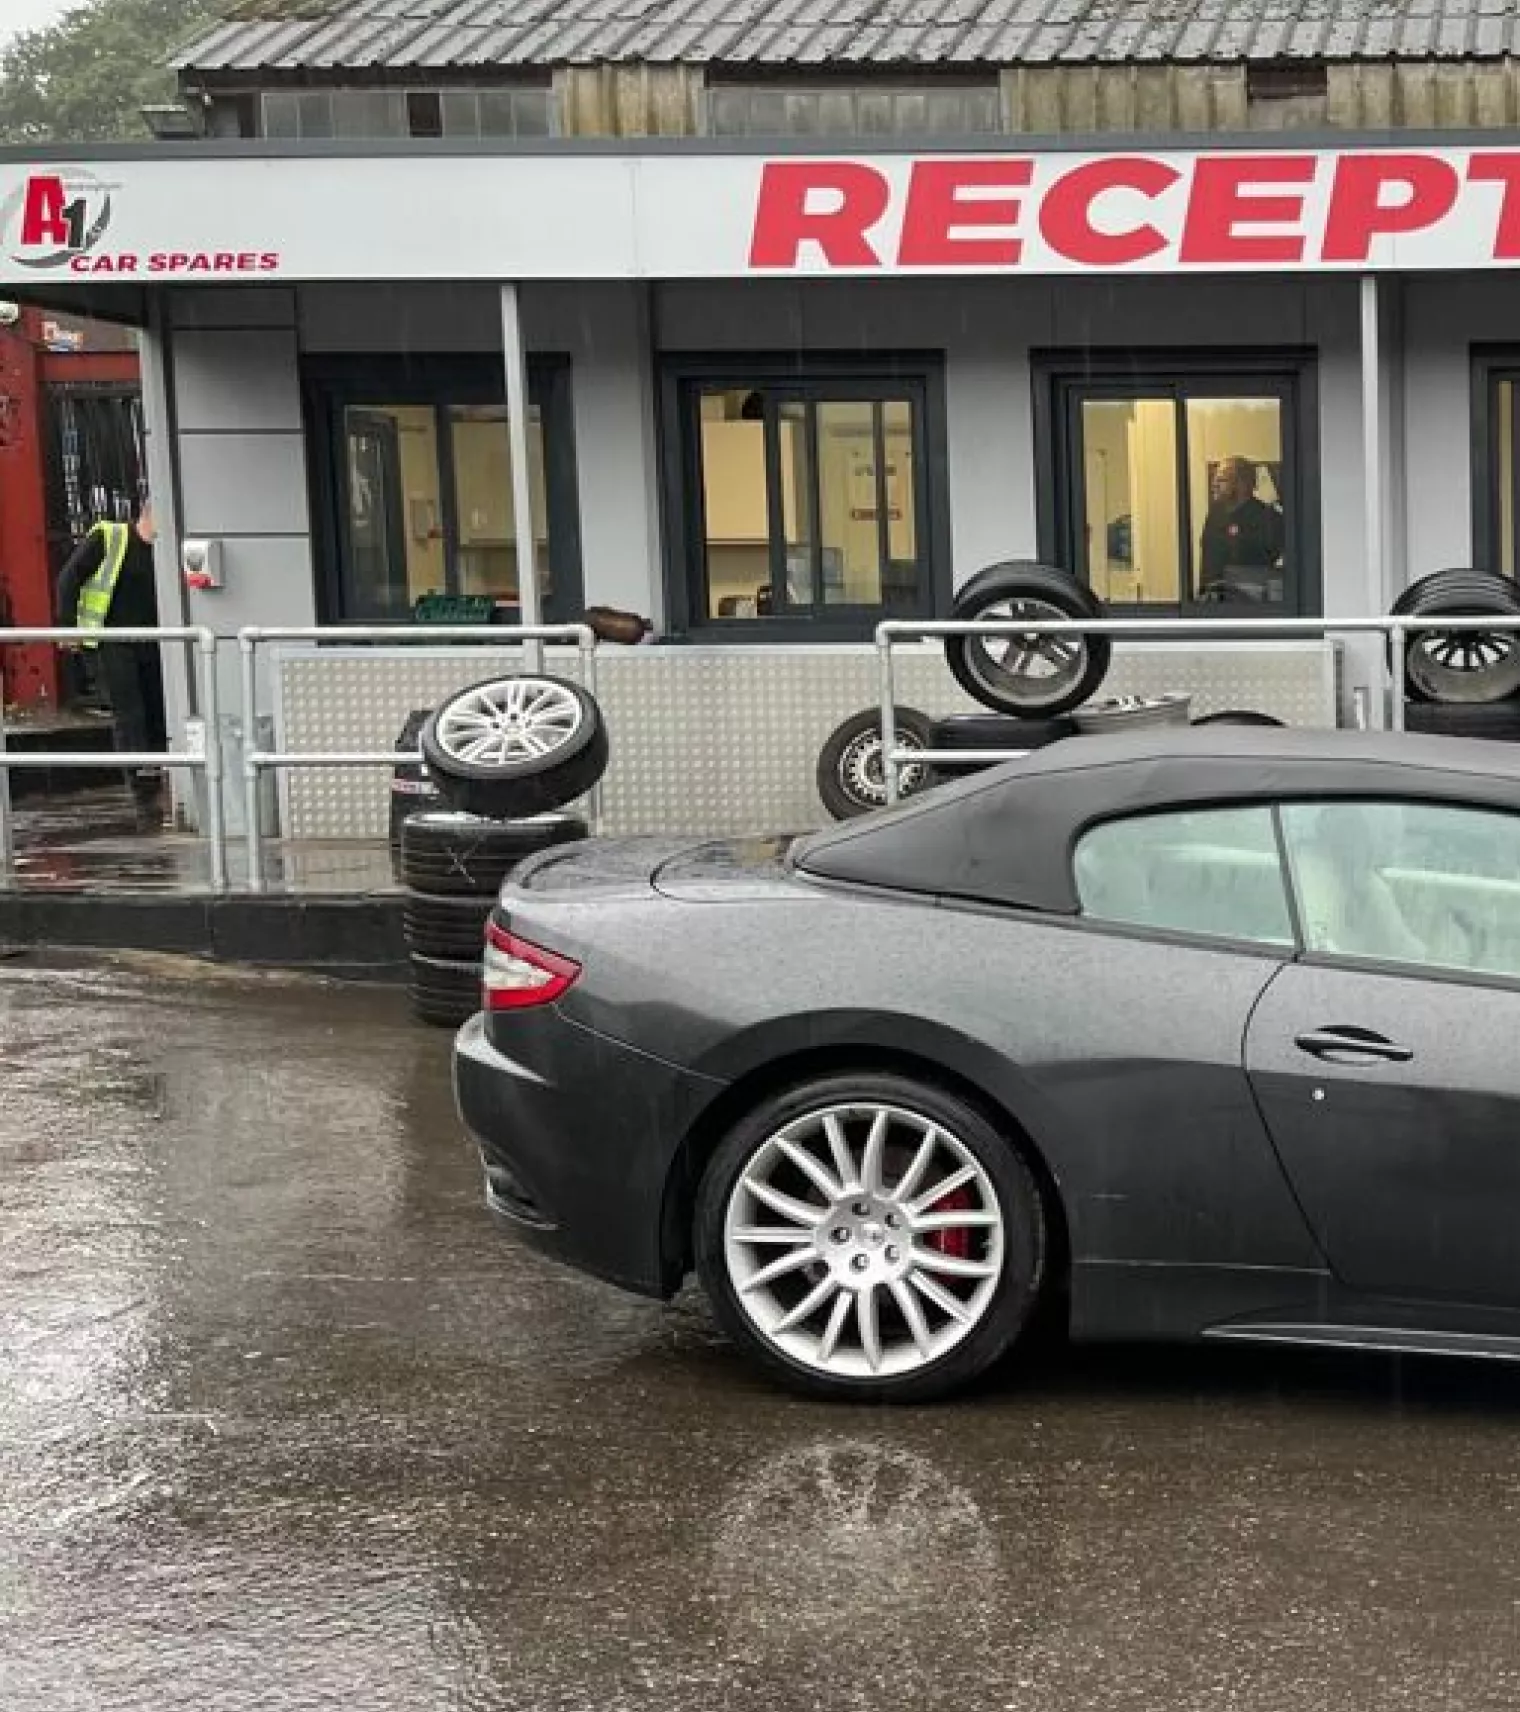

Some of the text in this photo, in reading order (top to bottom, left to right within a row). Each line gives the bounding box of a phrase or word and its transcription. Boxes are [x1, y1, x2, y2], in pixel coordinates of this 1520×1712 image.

[21, 176, 88, 248] A1
[70, 252, 280, 272] CAR SPARES
